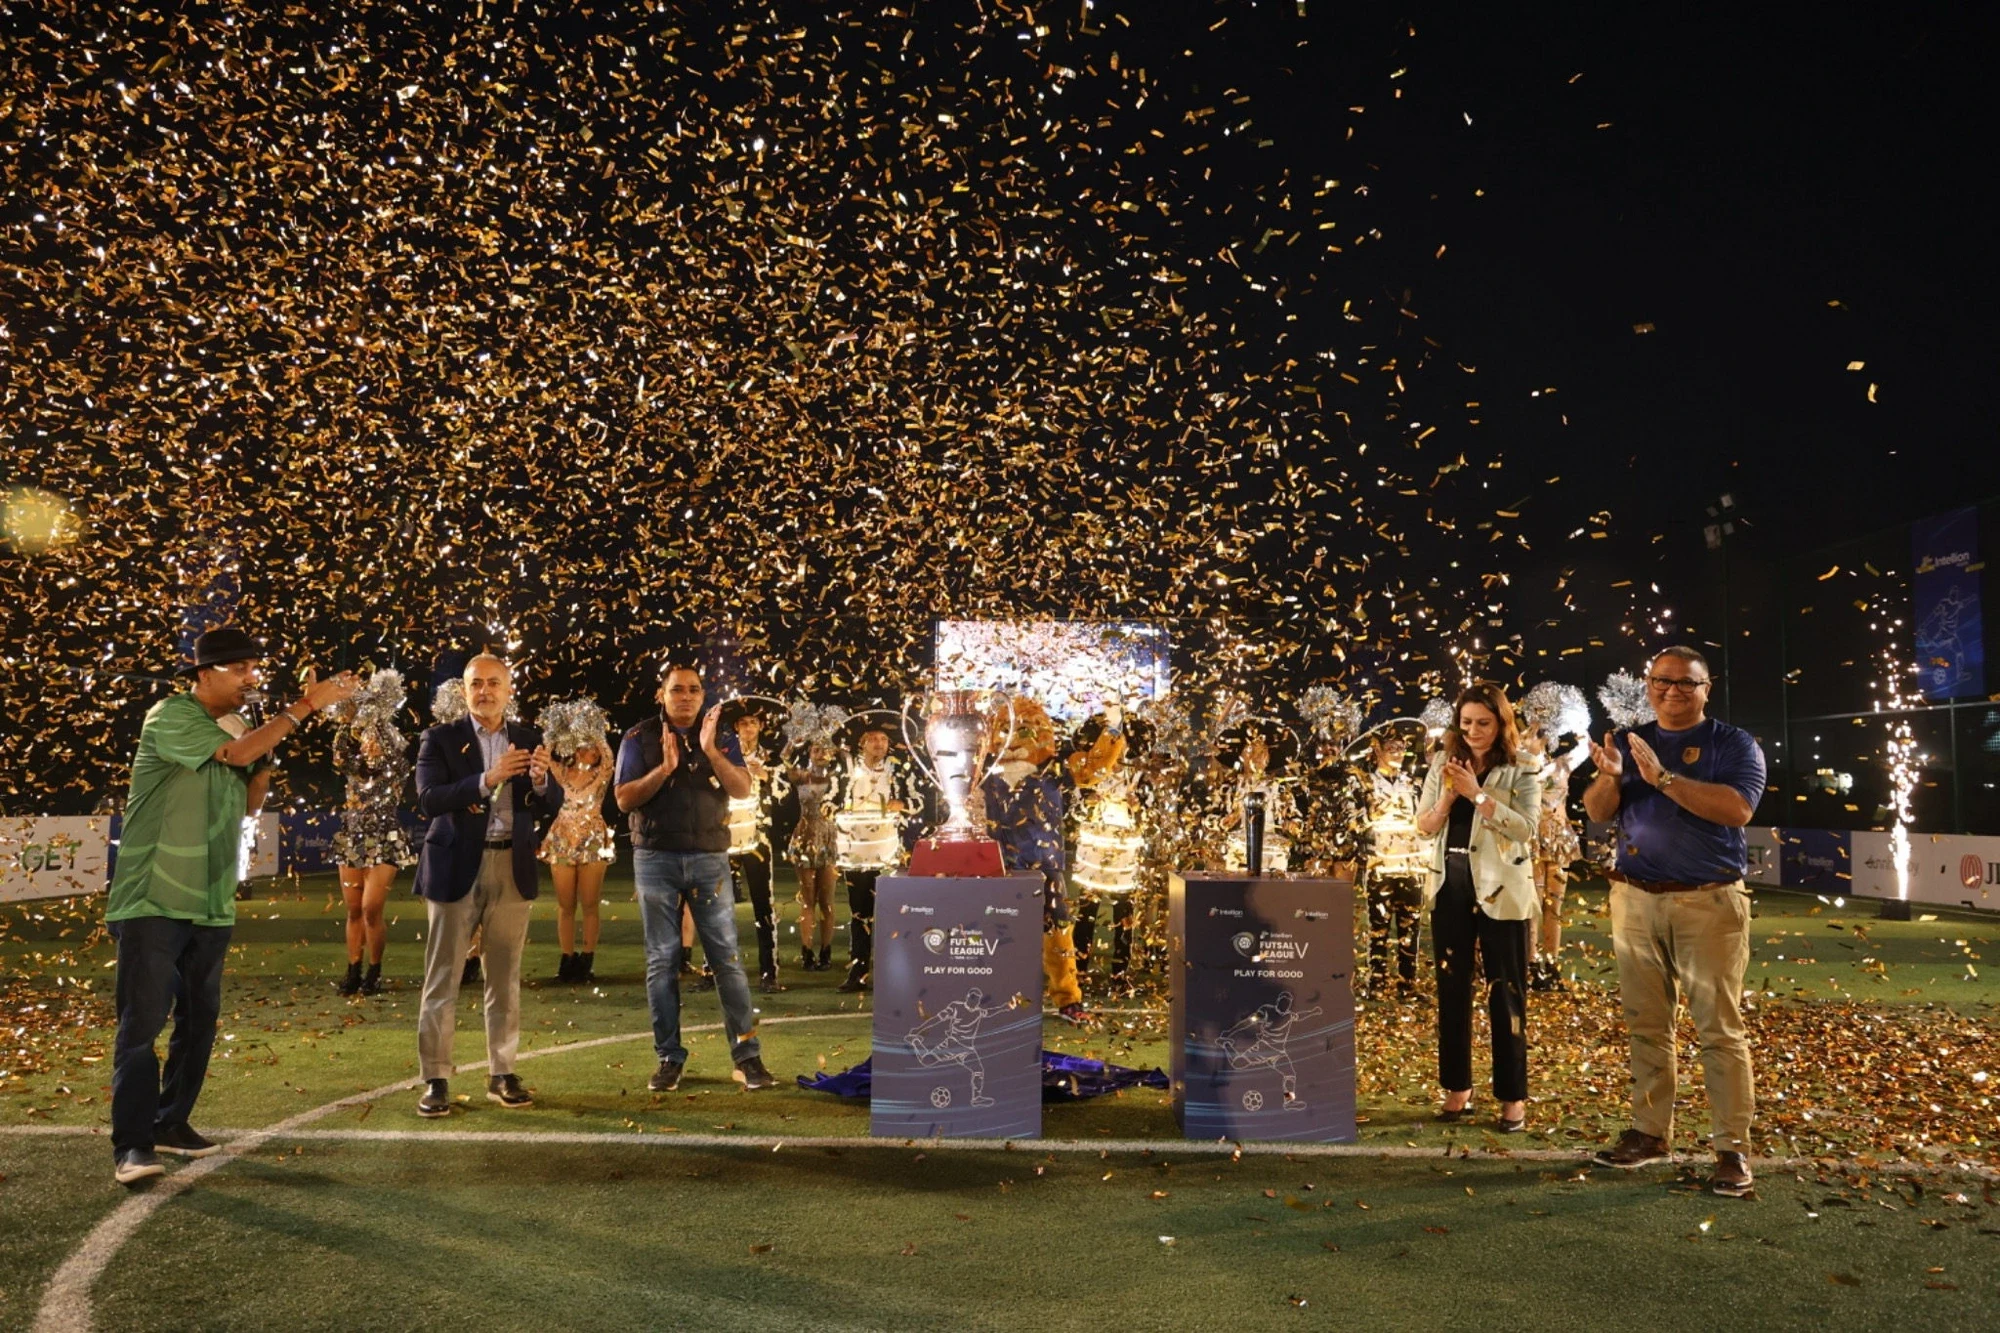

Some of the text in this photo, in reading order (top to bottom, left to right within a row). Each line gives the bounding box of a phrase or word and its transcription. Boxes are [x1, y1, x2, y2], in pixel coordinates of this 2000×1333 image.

[984, 939, 999, 956] V
[1259, 941, 1294, 950] FUTSAL
[950, 947, 984, 956] LEAGUE
[1294, 942, 1309, 959] V
[924, 966, 993, 975] PLAY FOR GOOD
[1234, 969, 1304, 979] PLAY FOR GOOD
